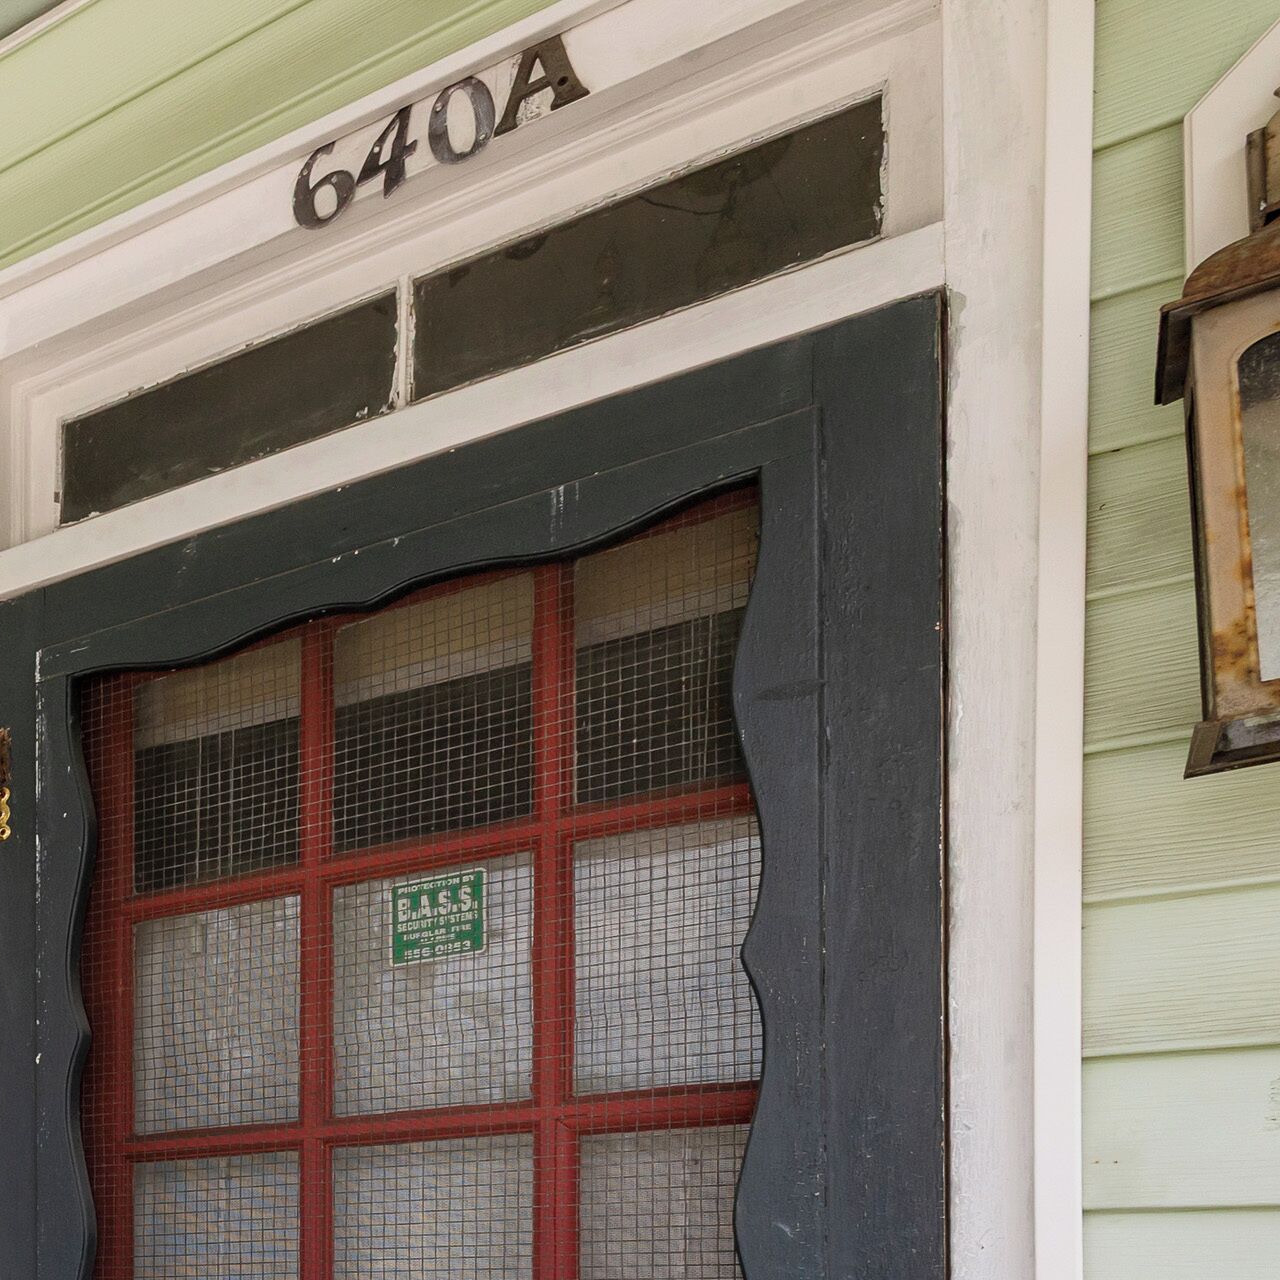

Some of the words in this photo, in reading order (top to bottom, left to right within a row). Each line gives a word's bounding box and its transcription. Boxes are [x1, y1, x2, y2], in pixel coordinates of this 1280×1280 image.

[292, 35, 591, 230] 640A
[398, 877, 460, 895] PROTECTION
[462, 874, 475, 883] BY
